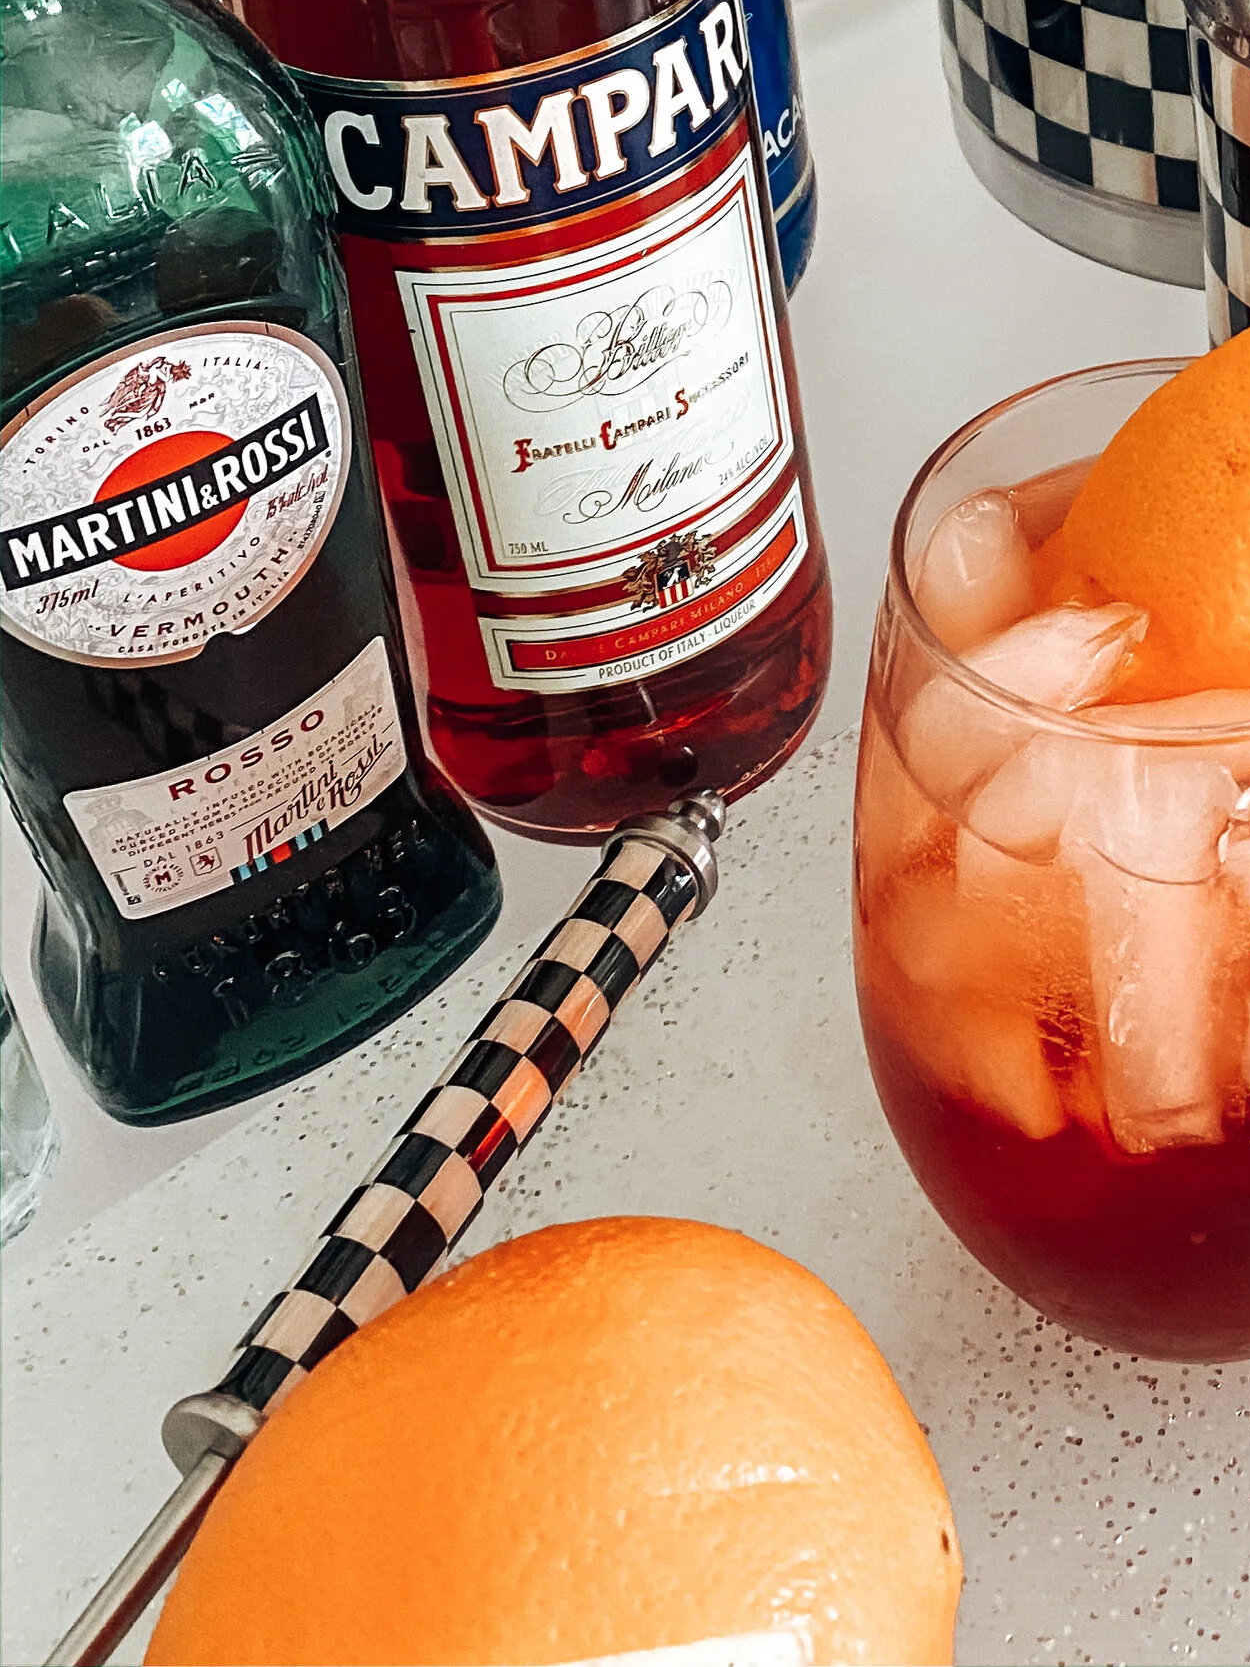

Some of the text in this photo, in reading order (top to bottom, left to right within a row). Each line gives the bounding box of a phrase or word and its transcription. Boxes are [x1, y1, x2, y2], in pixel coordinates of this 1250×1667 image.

[203, 356, 262, 370] ITALIA
[25, 406, 90, 466] TORINO
[134, 417, 172, 441] 1863
[599, 420, 671, 451] CAMPARI
[508, 541, 549, 555] 750 ML
[36, 579, 99, 614] 375ml
[110, 547, 289, 638] VERMOUTH
[599, 653, 656, 680] PRODUCT
[658, 648, 674, 662] OF
[677, 633, 708, 655] ITALY
[713, 598, 757, 635] LIQUEUR
[127, 828, 196, 857] DIFFERENT
[266, 765, 317, 800] AROUND
[338, 722, 376, 754] WORLD
[168, 709, 325, 802] ROSSO
[111, 828, 177, 854] SOURCED
[183, 809, 221, 829] FROM
[242, 760, 313, 803] SELECTION
[115, 811, 198, 844] NATURALLY
[205, 780, 265, 812] INFUSED
[271, 758, 302, 779] WITH
[242, 759, 338, 865] Martini
[143, 830, 224, 868] DAL 1863
